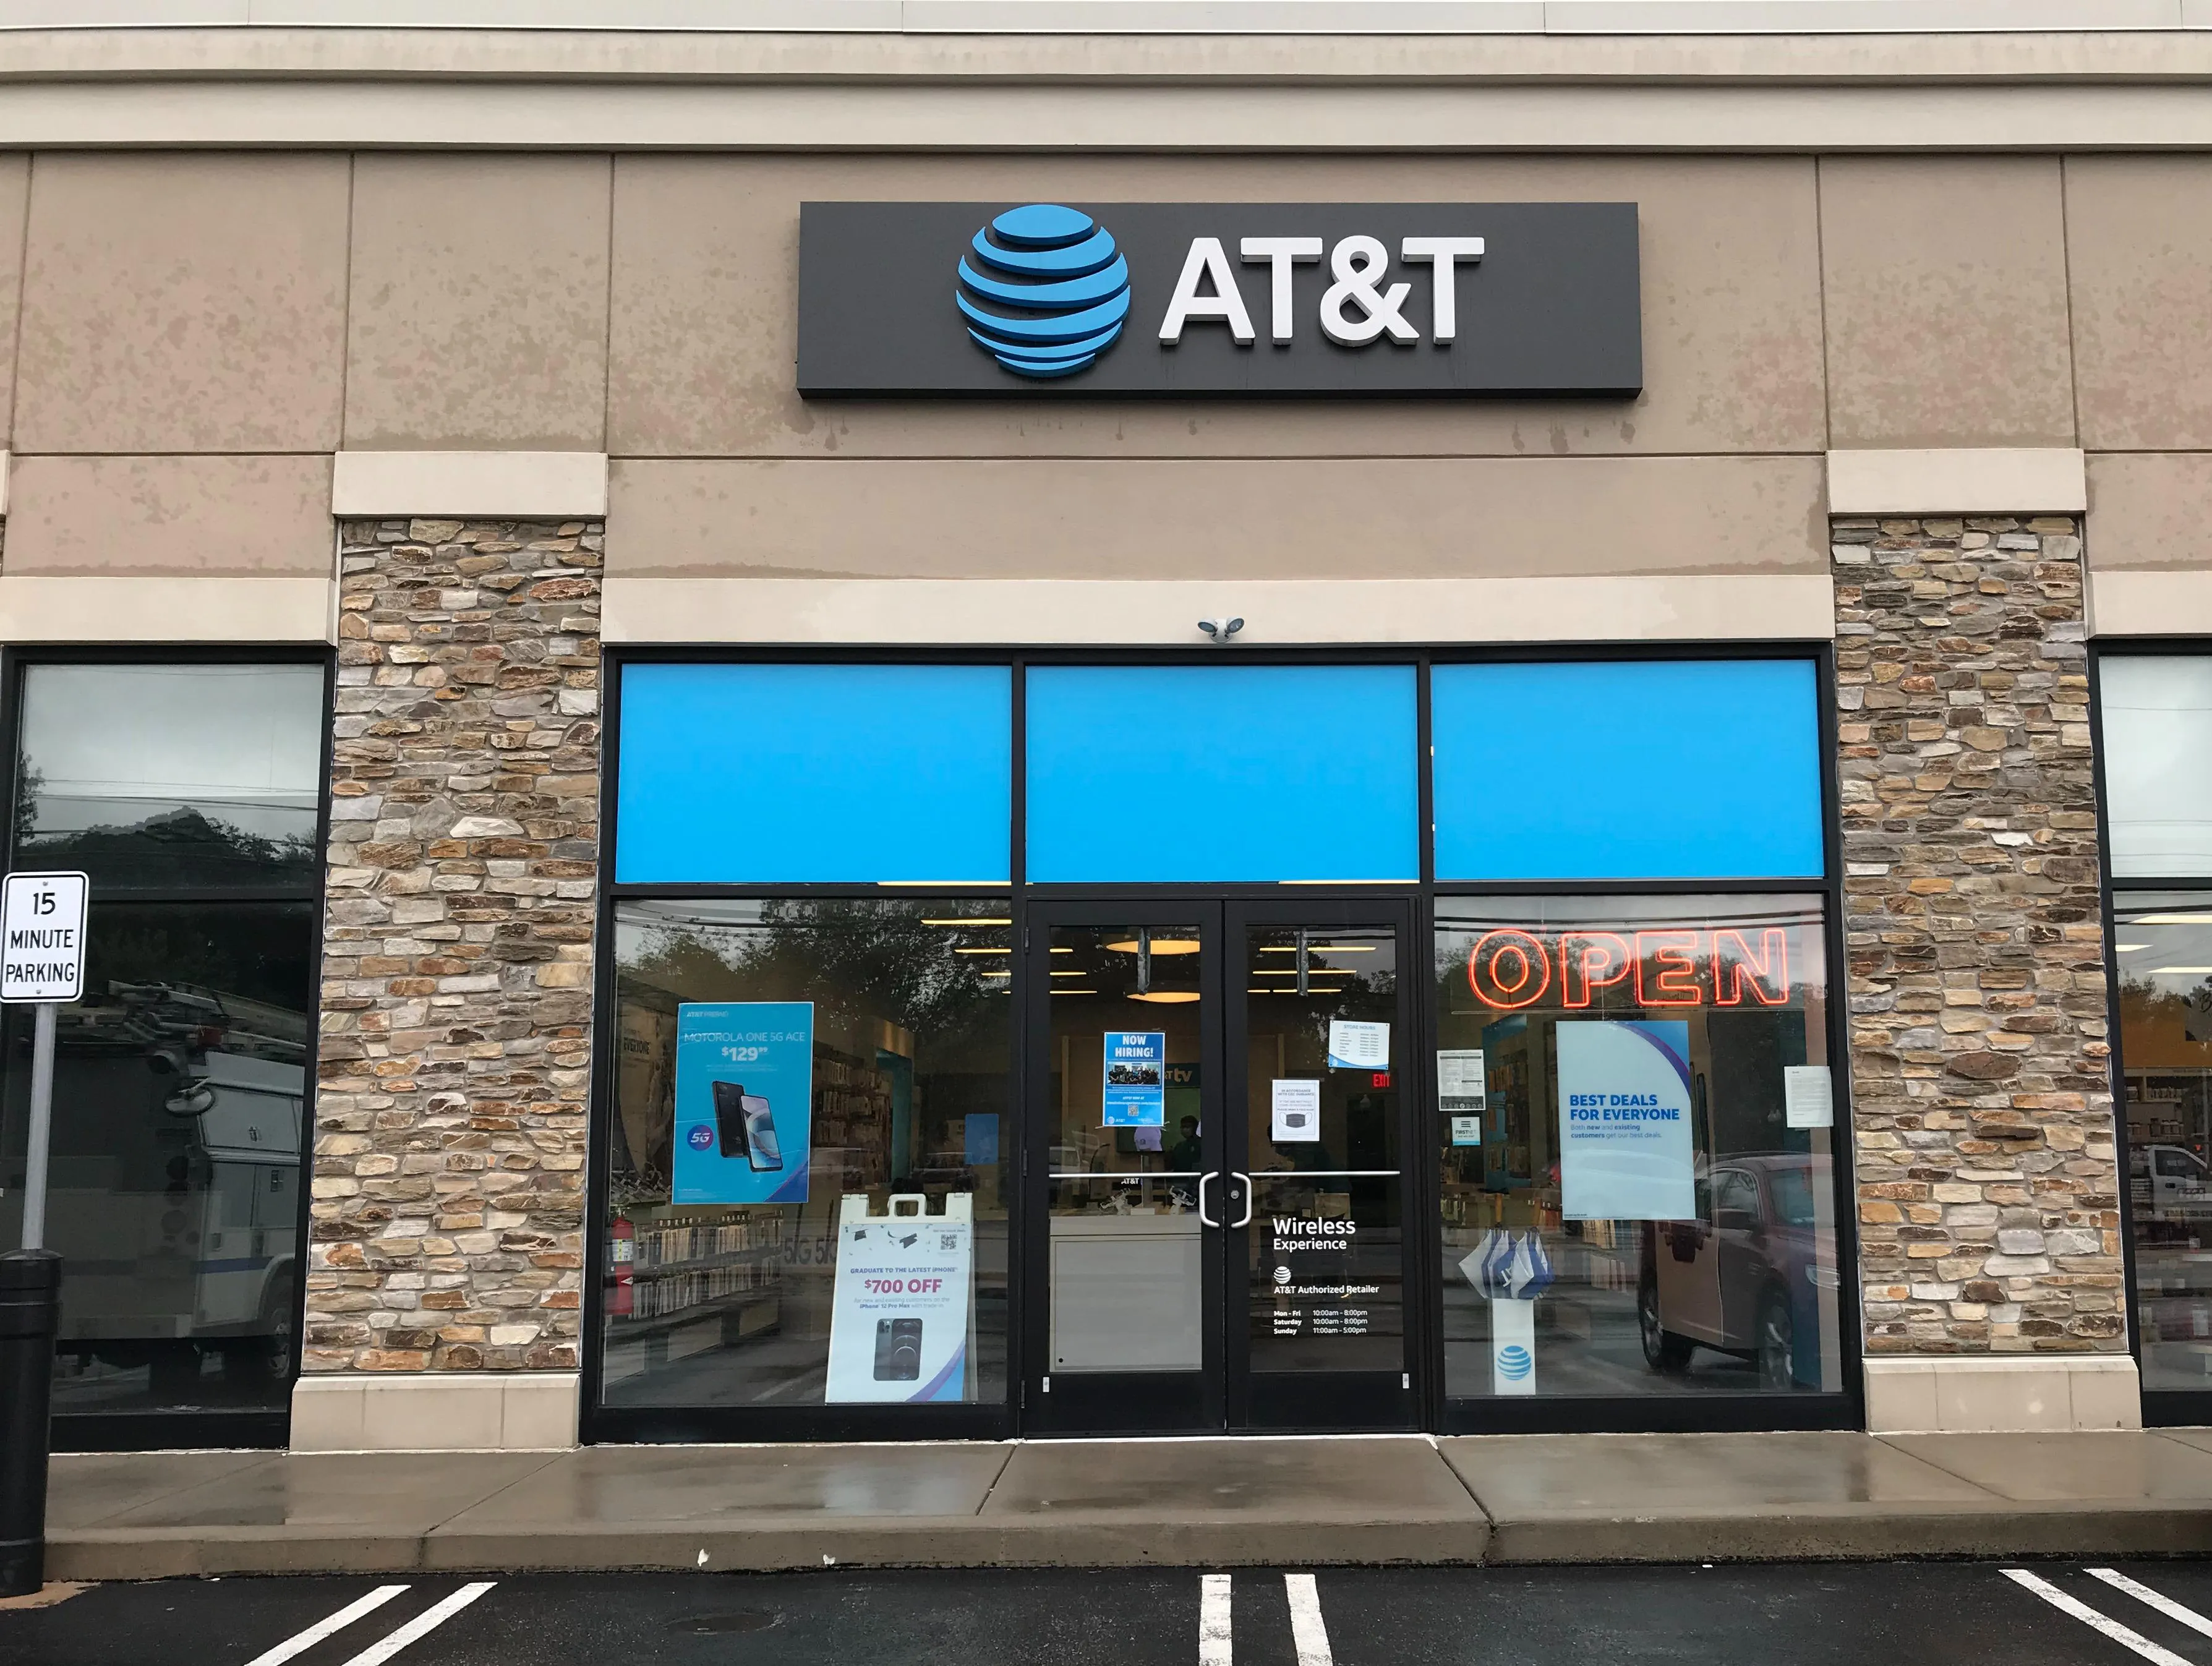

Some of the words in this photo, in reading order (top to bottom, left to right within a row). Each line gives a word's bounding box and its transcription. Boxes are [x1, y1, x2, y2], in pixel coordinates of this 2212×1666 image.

[1158, 235, 1485, 347] AT&T
[33, 892, 56, 915] 15
[11, 929, 74, 949] MINUTE
[6, 963, 75, 983] PARKING
[1468, 928, 1790, 1009] OPEN
[684, 1032, 743, 1042] MOTOROLA
[746, 1032, 768, 1042] ONE
[771, 1032, 784, 1042] 5G
[785, 1032, 806, 1042] ACE
[1122, 1035, 1147, 1045] NOW
[1115, 1047, 1154, 1057] HIRING!
[1174, 1067, 1193, 1082] tv
[1373, 1074, 1390, 1087] EXIT
[1569, 1095, 1607, 1106] BEST
[1610, 1095, 1658, 1106] DEALS
[1570, 1109, 1600, 1121] FOR
[1603, 1109, 1680, 1120] EVERYONE
[690, 1132, 711, 1143] 5G
[1273, 1216, 1356, 1235] Wireless
[1273, 1237, 1347, 1253] Experience
[864, 1279, 903, 1294] $700
[907, 1278, 943, 1293] OFF
[1273, 1286, 1296, 1294] AT&T
[1297, 1285, 1345, 1294] Authorized
[1346, 1285, 1380, 1294] Retailer
[1273, 1318, 1302, 1326] Saturday
[1344, 1318, 1368, 1326] 8:00pm
